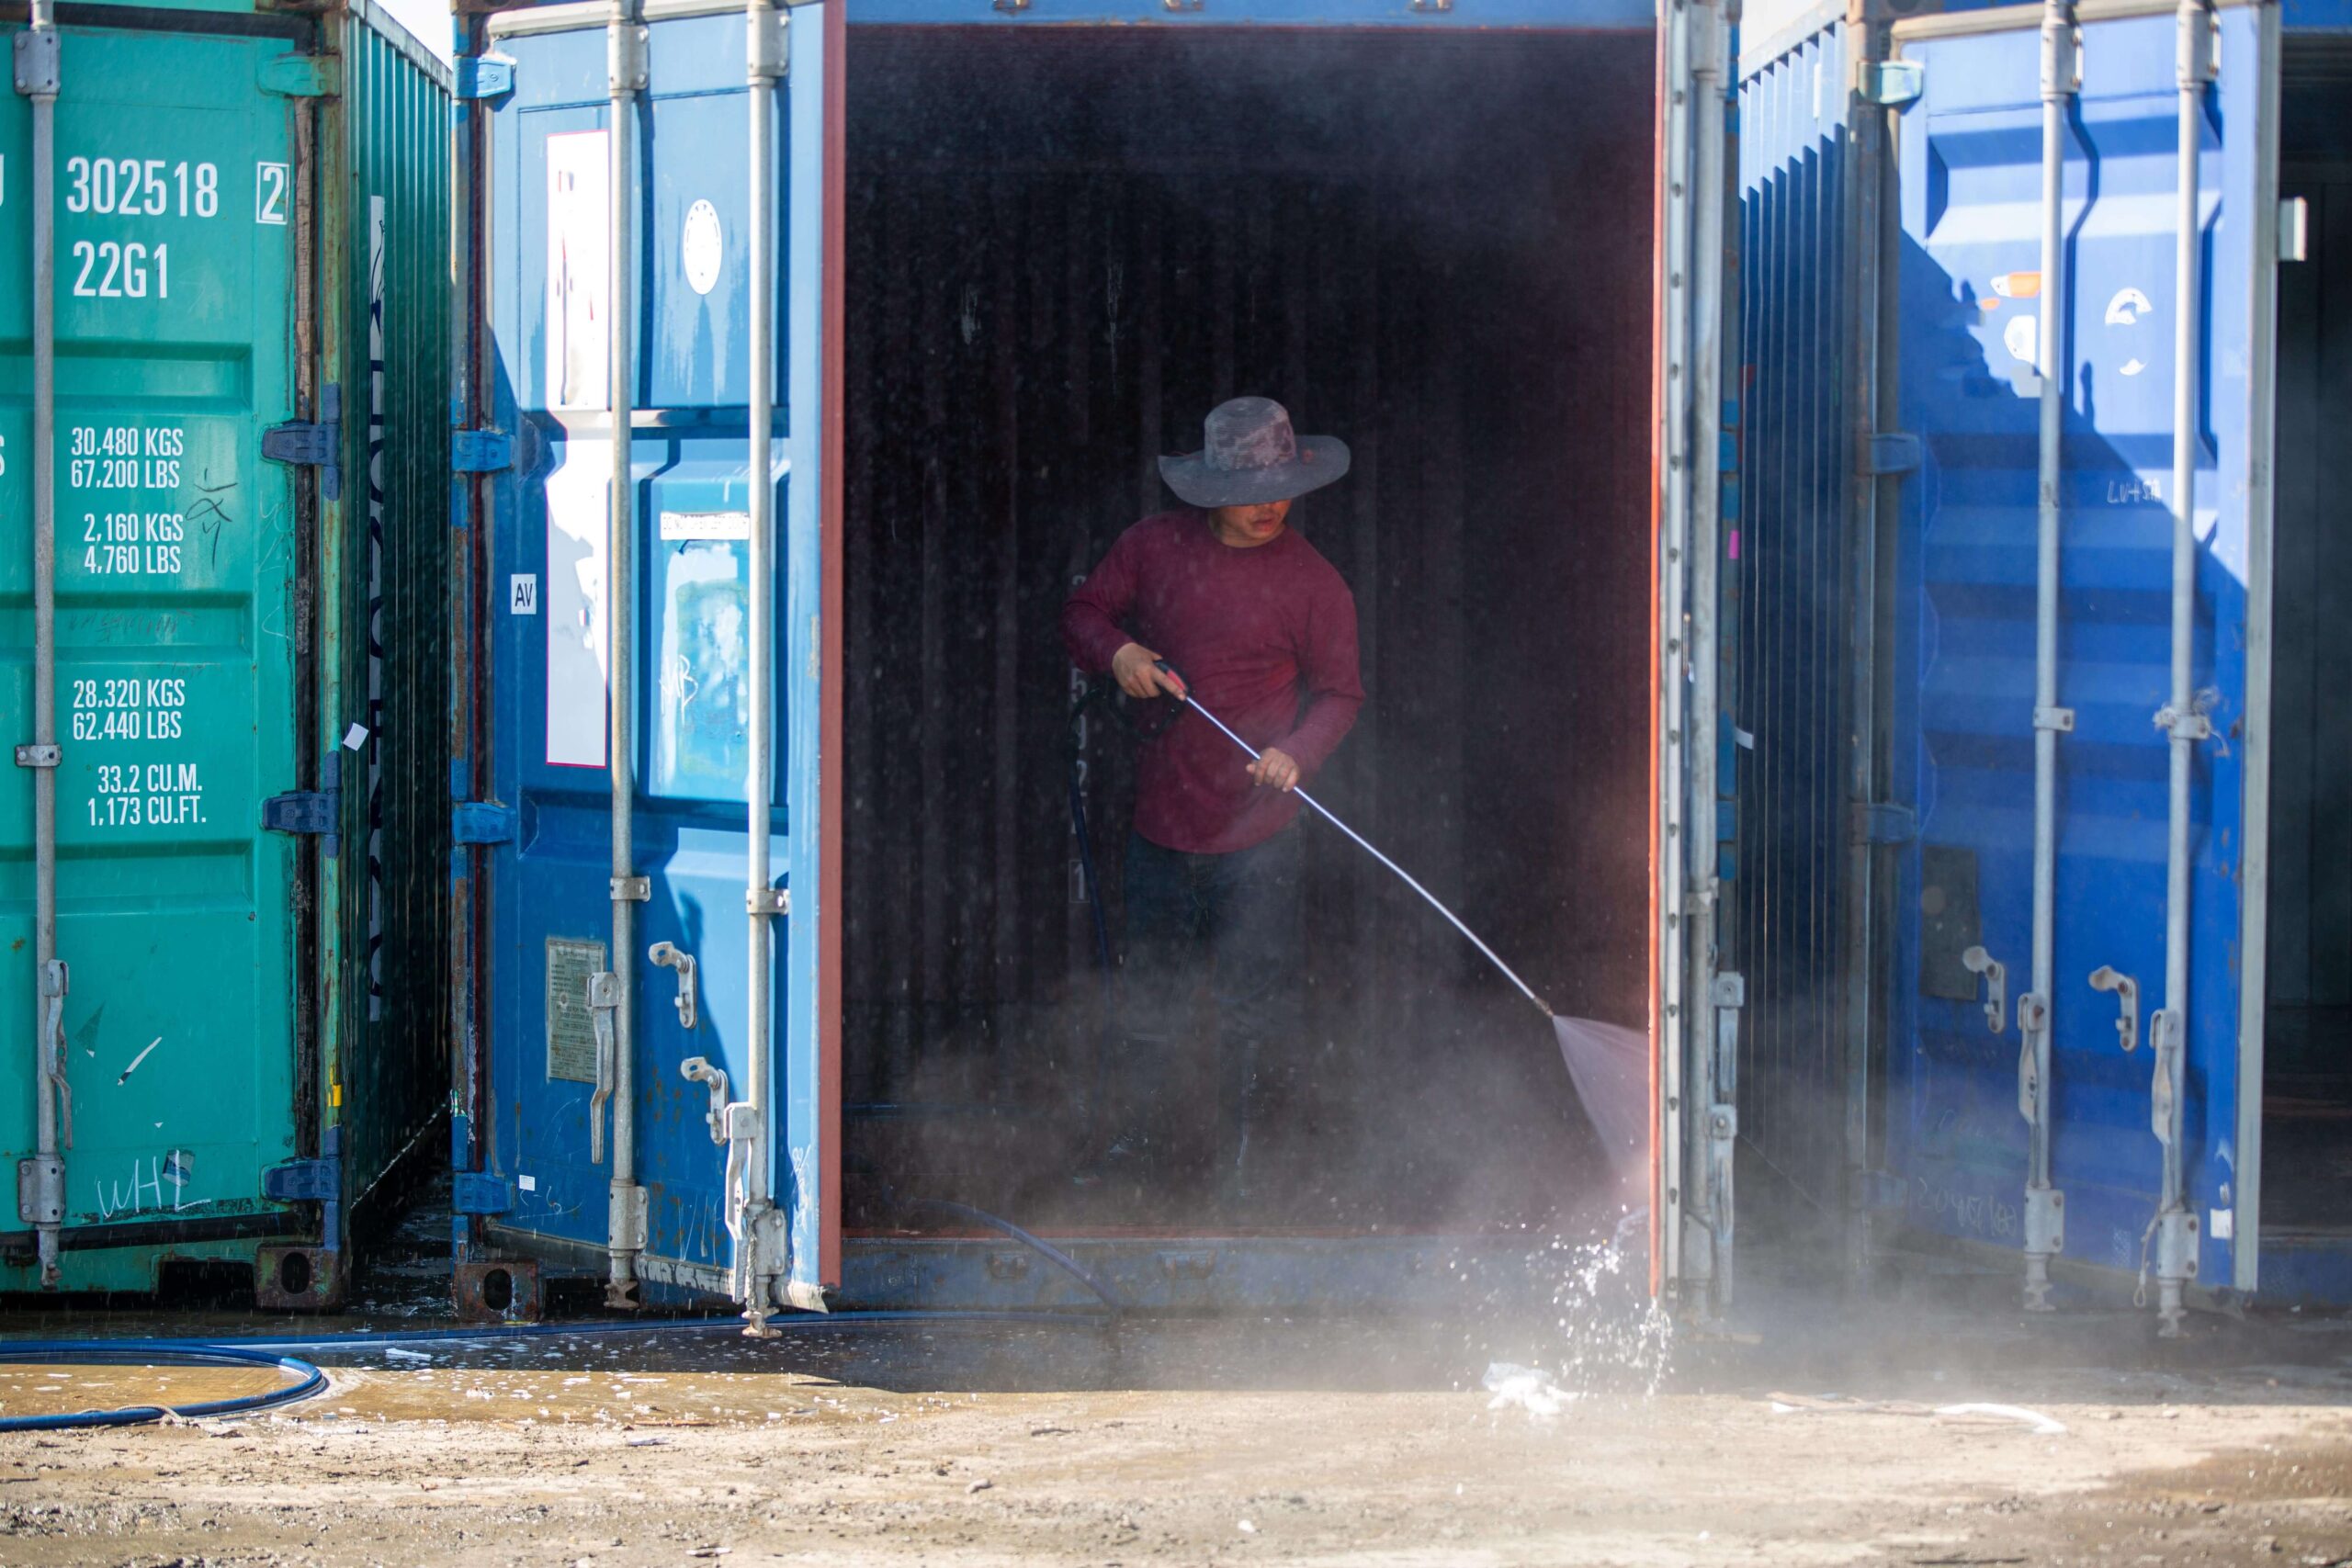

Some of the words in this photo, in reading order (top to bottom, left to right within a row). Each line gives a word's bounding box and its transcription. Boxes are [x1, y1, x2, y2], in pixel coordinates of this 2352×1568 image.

[66, 156, 219, 218] 302518
[261, 165, 285, 221] 2
[73, 241, 168, 299] 22G1
[71, 427, 139, 457] 30,480
[145, 427, 184, 457] KGS
[71, 459, 139, 491] 67,200
[144, 459, 180, 489] LBS
[84, 513, 139, 544] 2,160
[145, 513, 185, 542] KGS
[84, 545, 140, 574] 4,760
[145, 545, 182, 574] LBS
[514, 582, 533, 607] AV
[73, 679, 141, 709] 28,320
[147, 678, 186, 708] KGS
[73, 711, 141, 740] 62,440
[147, 710, 182, 739] LBS
[97, 764, 141, 794] 33.2
[147, 763, 203, 793] CU.M.
[87, 796, 141, 826] 1,173
[147, 795, 207, 824] CU.FT.
[96, 1149, 211, 1219] WHL
